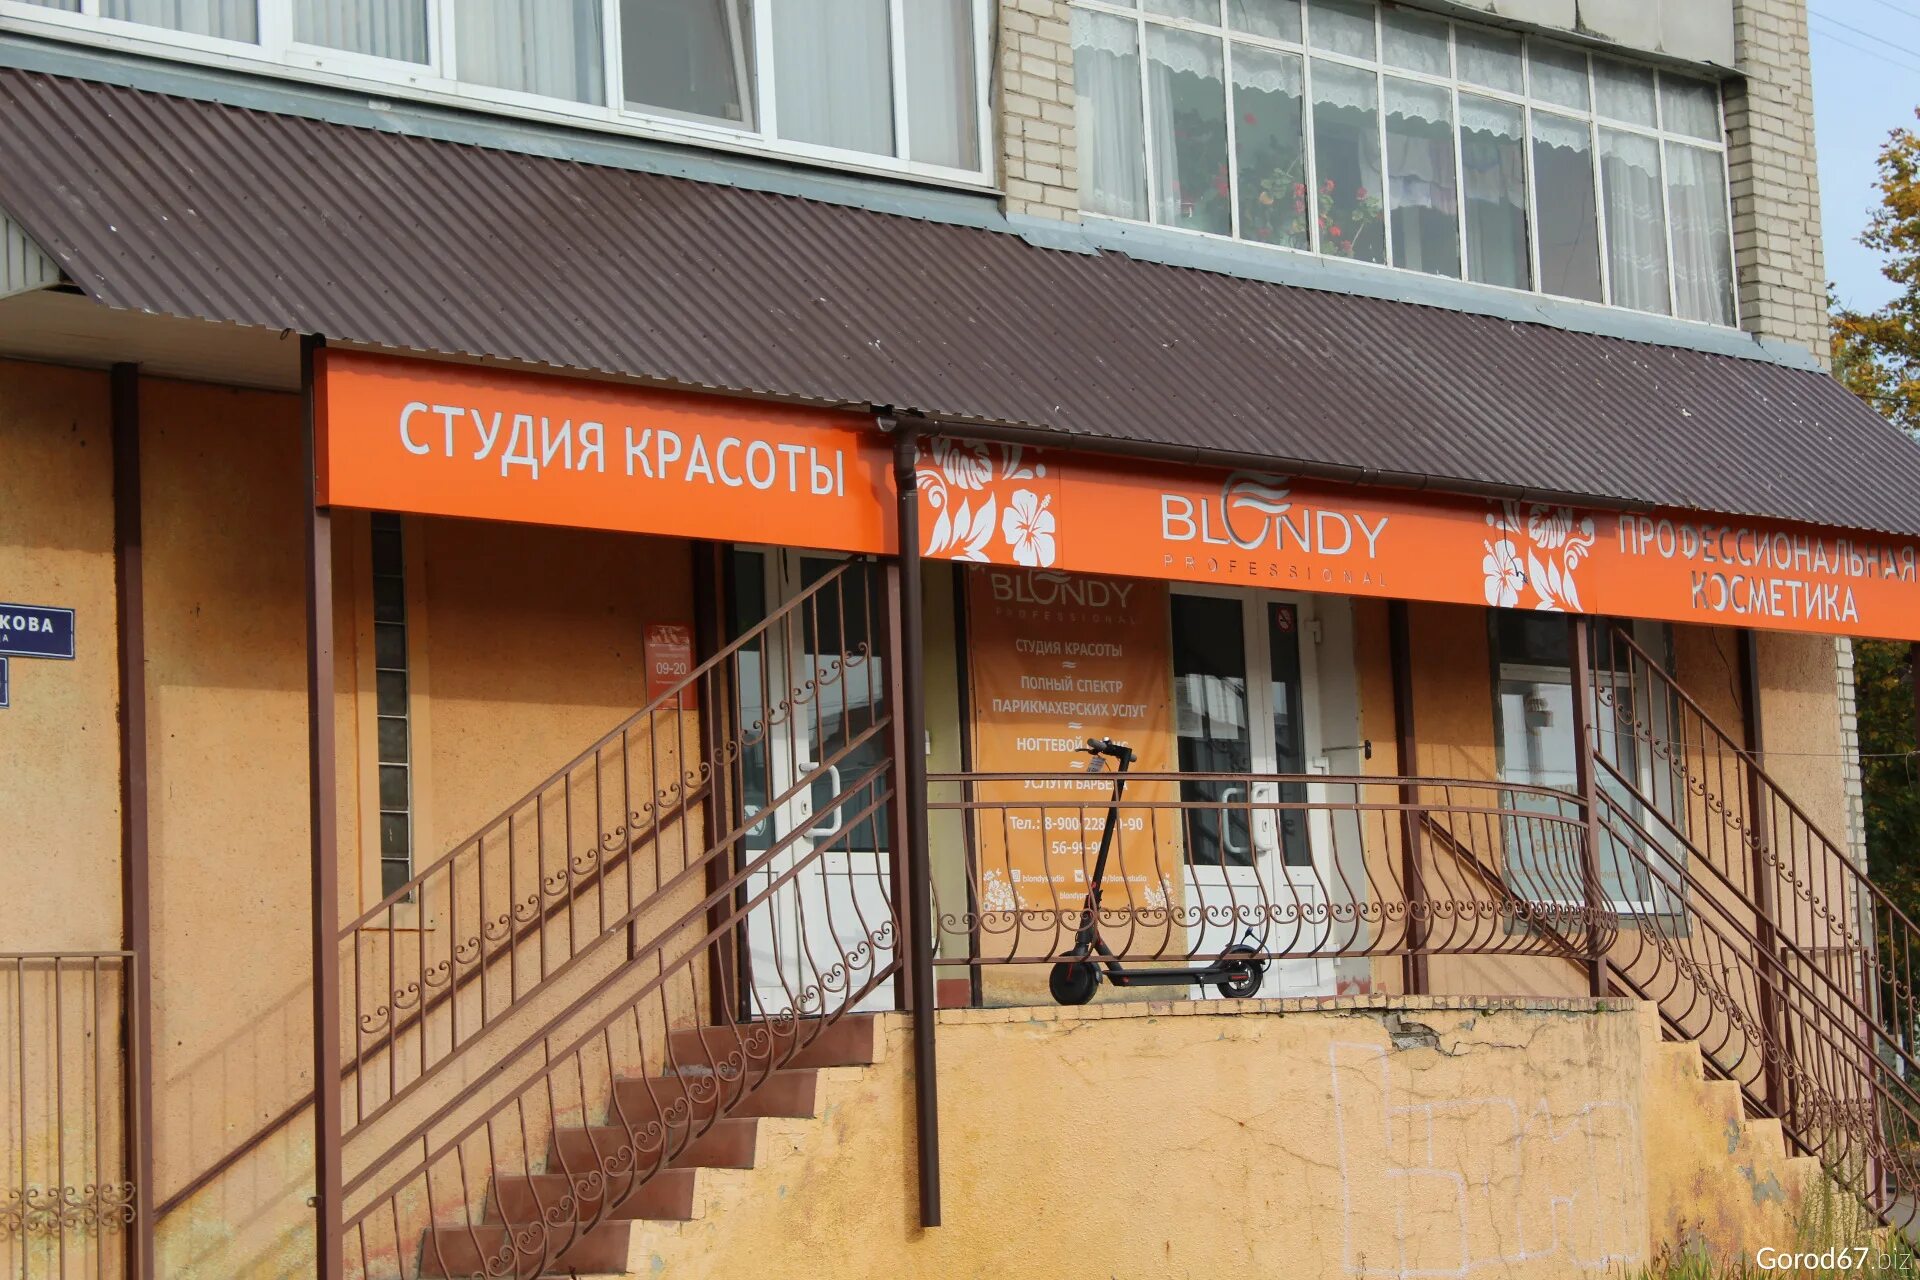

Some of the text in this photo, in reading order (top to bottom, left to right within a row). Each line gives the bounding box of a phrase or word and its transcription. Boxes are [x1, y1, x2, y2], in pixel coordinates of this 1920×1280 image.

[399, 401, 845, 497] СТУДИЯ КРАСОТЫ
[1161, 473, 1389, 559] BLONDY
[1618, 514, 1918, 583] ПРОФЕССИОНАЛЬНАЯ
[1163, 553, 1388, 587] PROFESSIONAL
[990, 570, 1134, 608] BLONDY
[1691, 569, 1859, 624] КОСМЕТИКА
[995, 607, 1137, 626] PROFESSIONAL
[1015, 637, 1123, 657] СТУДИЯ КРАСОТЫ
[655, 662, 687, 675] 09-20
[1021, 674, 1124, 694] ПОЛНЫЙ СПЕКТР
[992, 698, 1148, 718] ПАРИКМАХЕРСКИХ УСЛУГ
[1016, 736, 1084, 752] НОГТЕВОЙ
[1009, 816, 1041, 831] Тел.:
